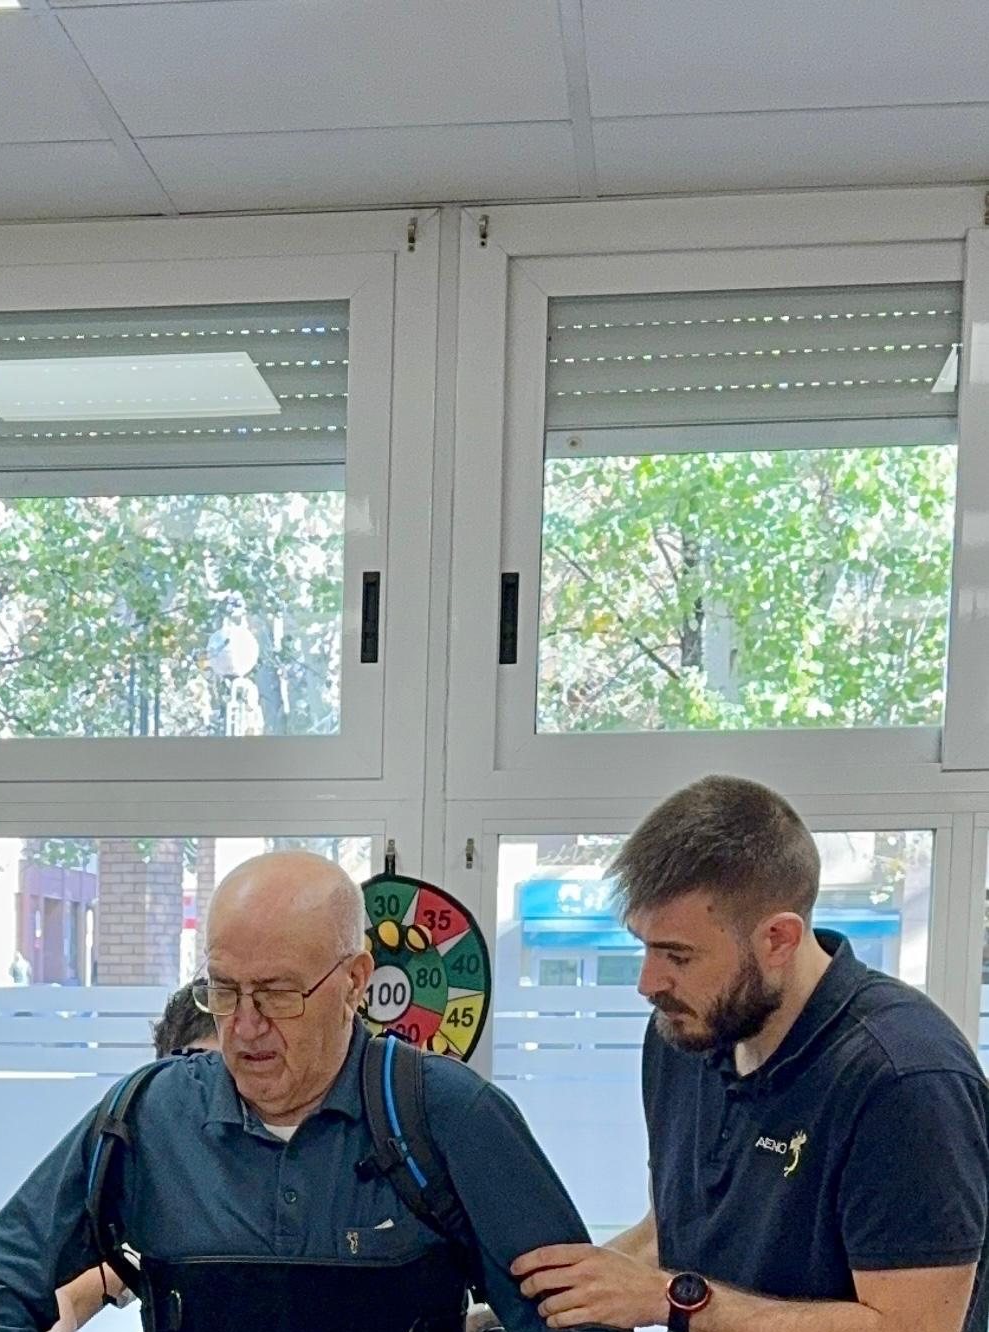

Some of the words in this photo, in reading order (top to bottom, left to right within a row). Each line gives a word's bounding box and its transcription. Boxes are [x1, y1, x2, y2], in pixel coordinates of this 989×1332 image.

[373, 894, 400, 917] 30
[423, 909, 451, 931] 35
[452, 954, 480, 975] 40
[416, 967, 442, 989] 80
[365, 982, 407, 1007] 100
[446, 1007, 474, 1028] 45
